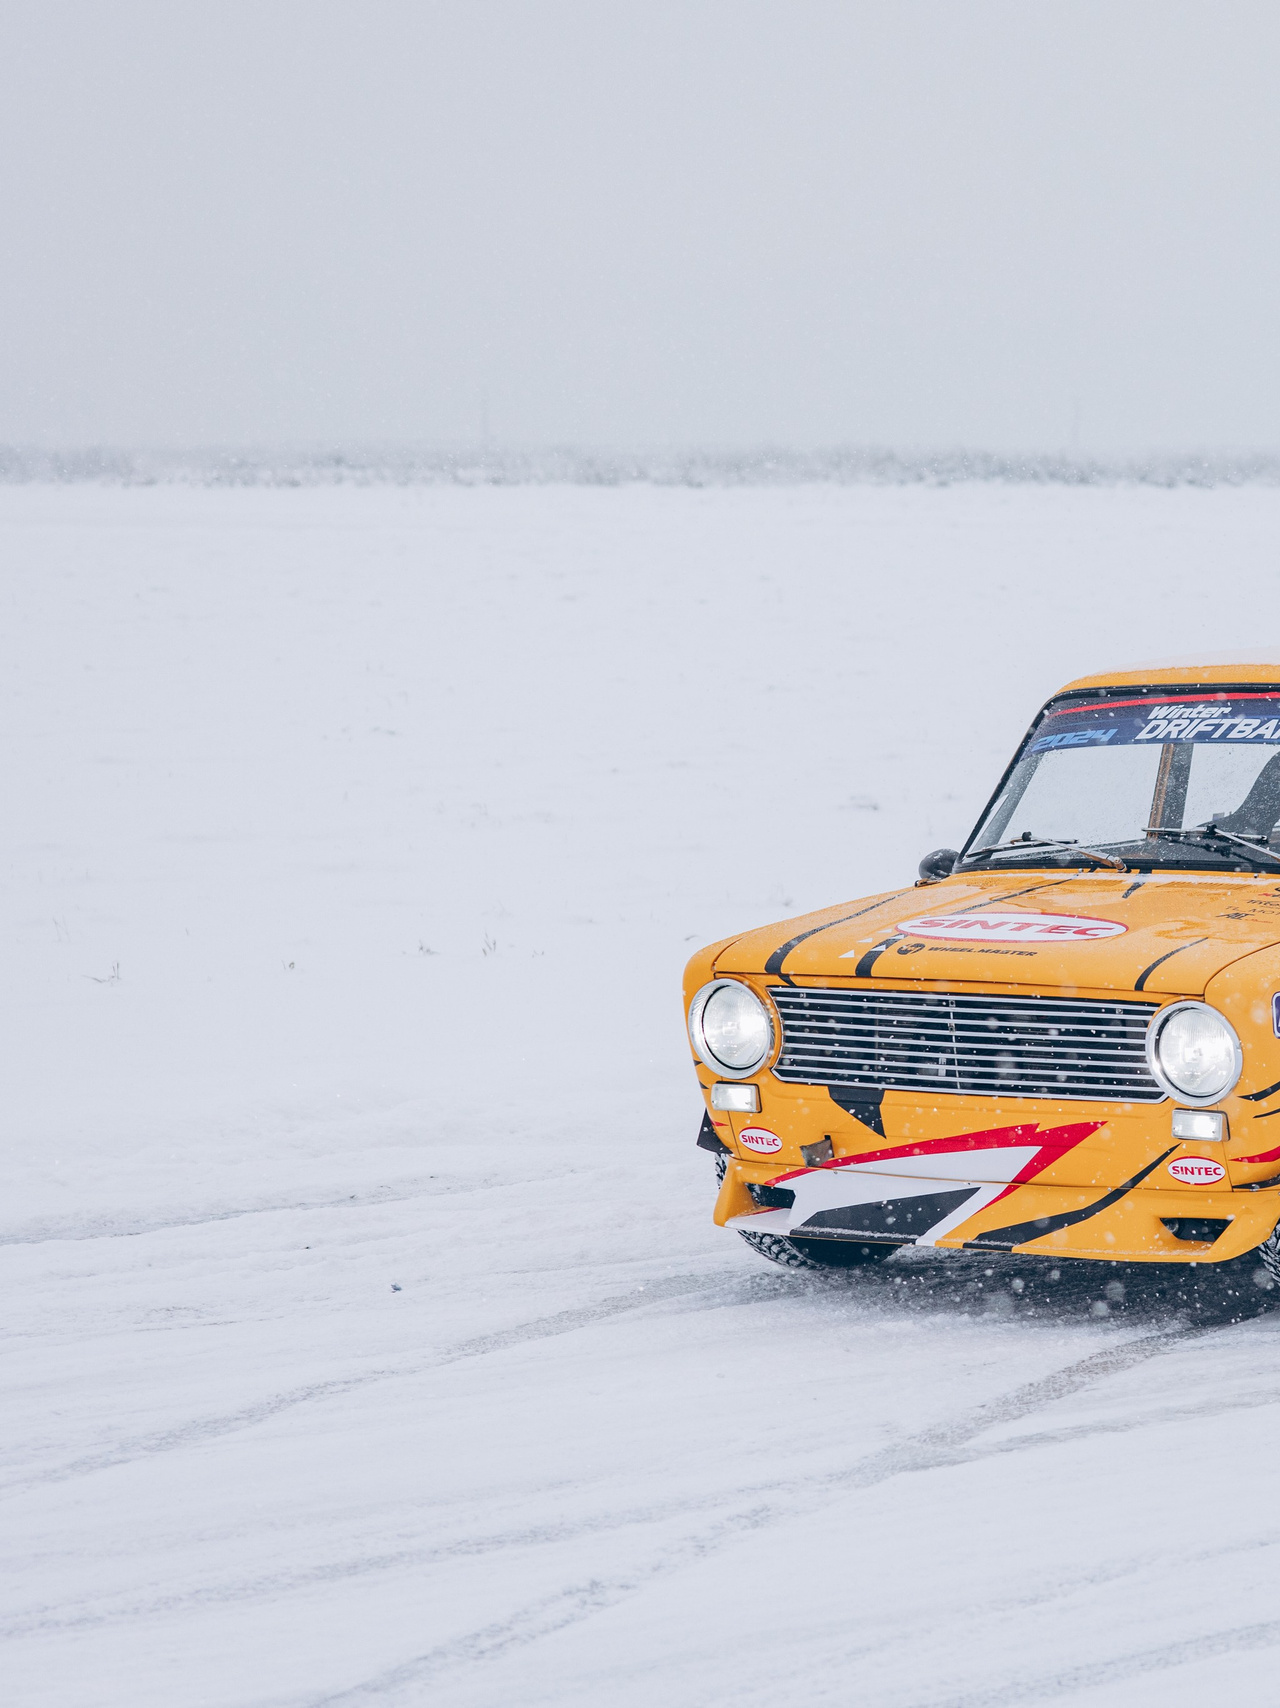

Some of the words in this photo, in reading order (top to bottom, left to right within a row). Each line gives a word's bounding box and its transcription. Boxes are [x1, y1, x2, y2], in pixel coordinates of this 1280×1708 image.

[1147, 704, 1232, 720] Winter
[1031, 728, 1118, 752] 2024
[909, 919, 1115, 937] SINTEC
[741, 1134, 779, 1146] SINTEC
[1171, 1166, 1222, 1176] SINTEC
